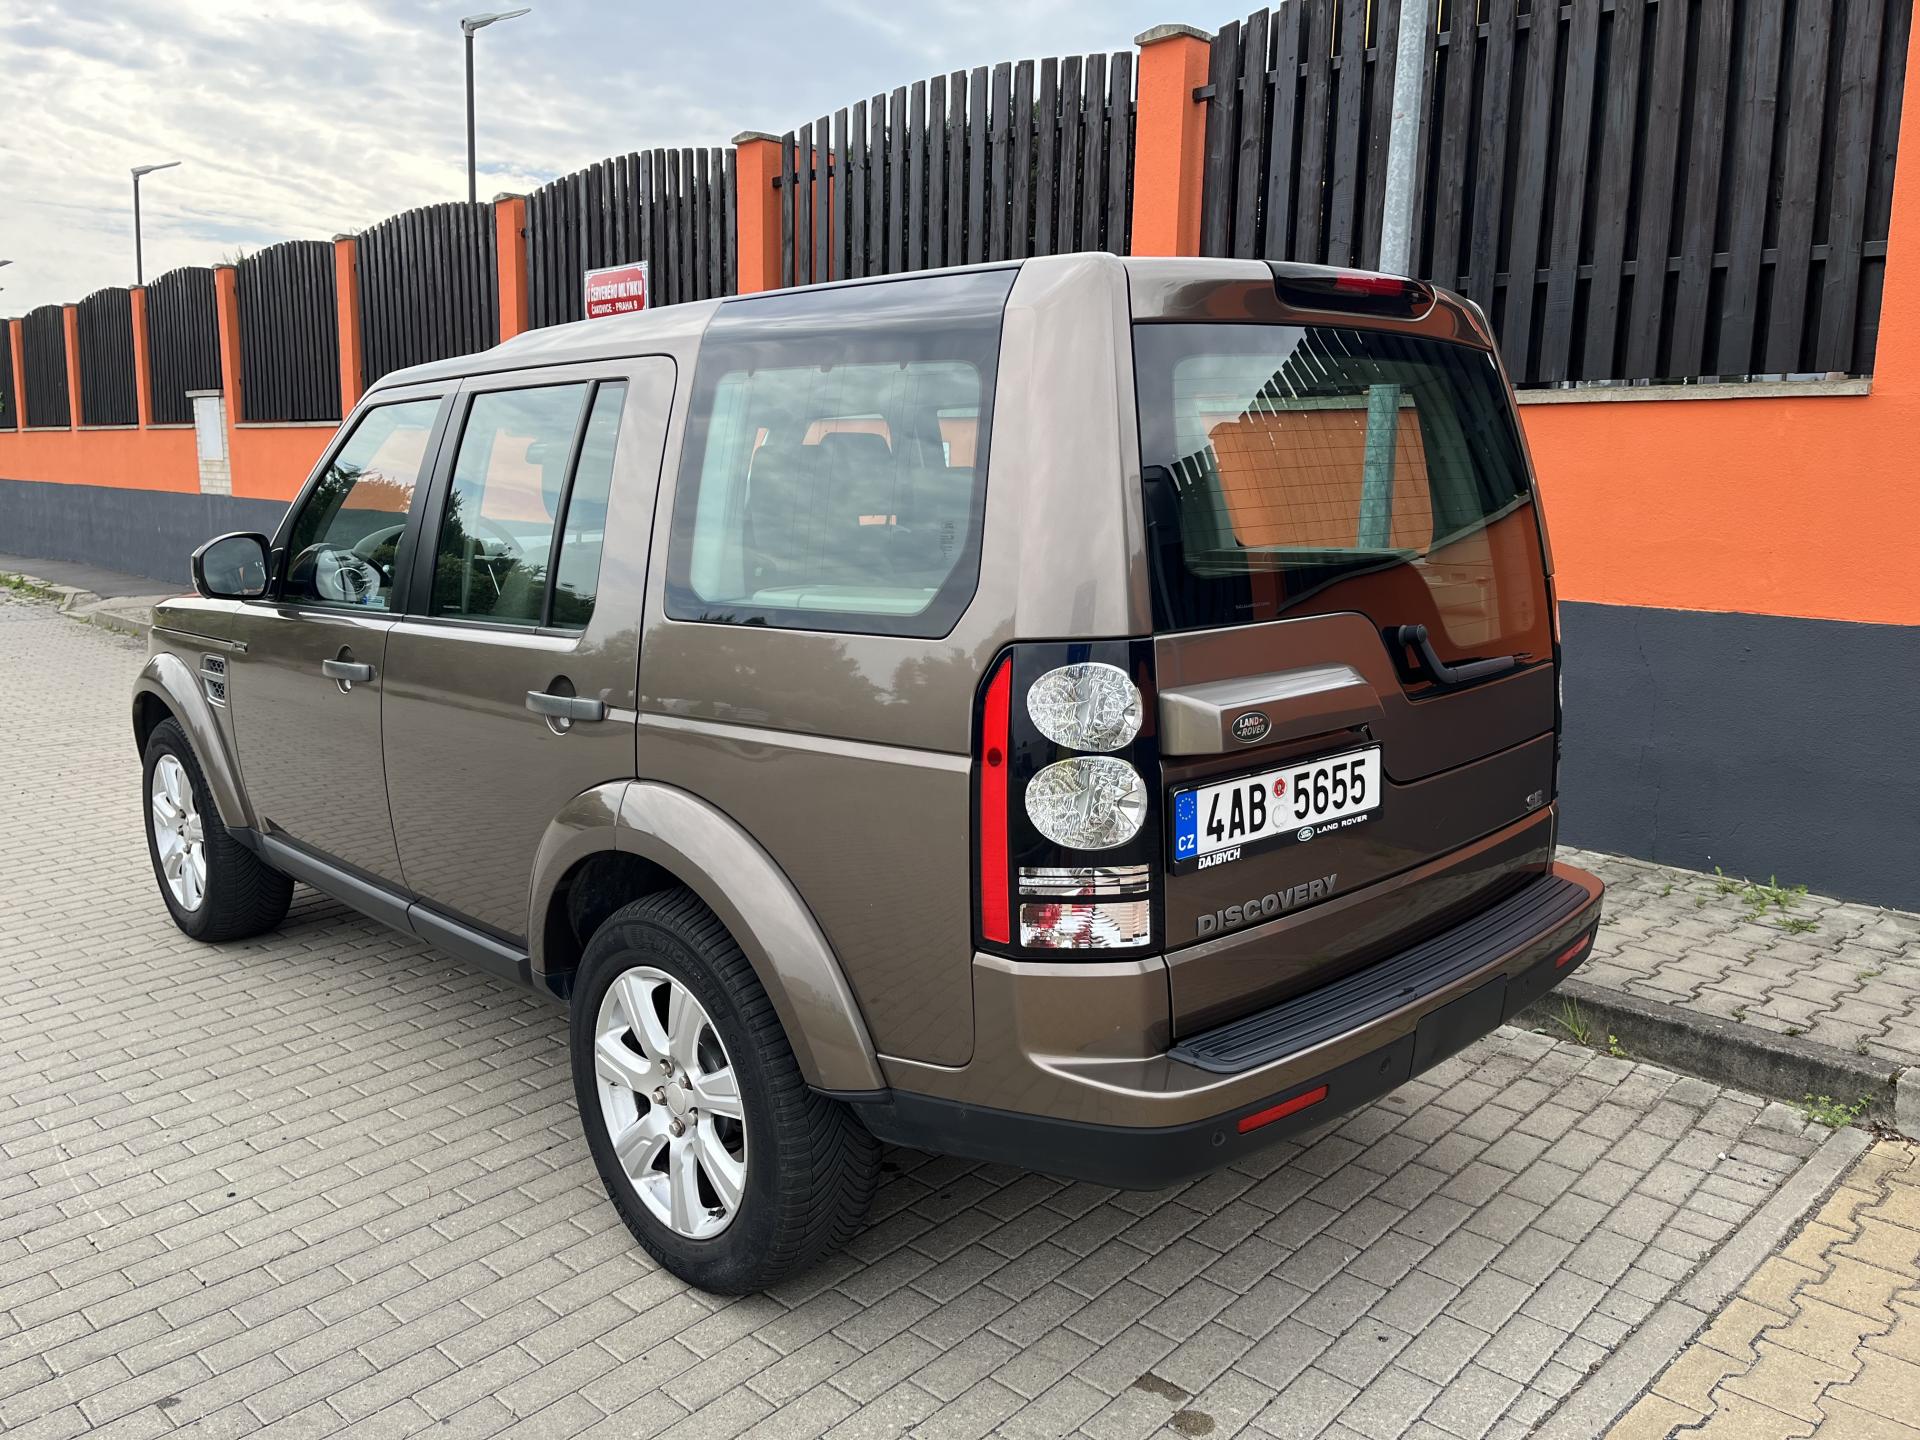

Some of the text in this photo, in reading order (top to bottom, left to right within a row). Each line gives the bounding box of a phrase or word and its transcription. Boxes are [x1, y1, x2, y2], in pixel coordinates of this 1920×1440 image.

[618, 278, 642, 297] MLÝNKU
[615, 301, 633, 312] PRAHA
[633, 300, 638, 309] 9
[1240, 717, 1259, 728] LAND
[1241, 724, 1265, 736] ROVER
[1206, 758, 1366, 843] 4AB 5655
[1316, 822, 1339, 834] LAND
[1341, 814, 1368, 827] ROVER
[1178, 834, 1195, 852] CZ
[1198, 848, 1241, 870] DAJBYCH
[1197, 873, 1338, 936] DISCOVERY
